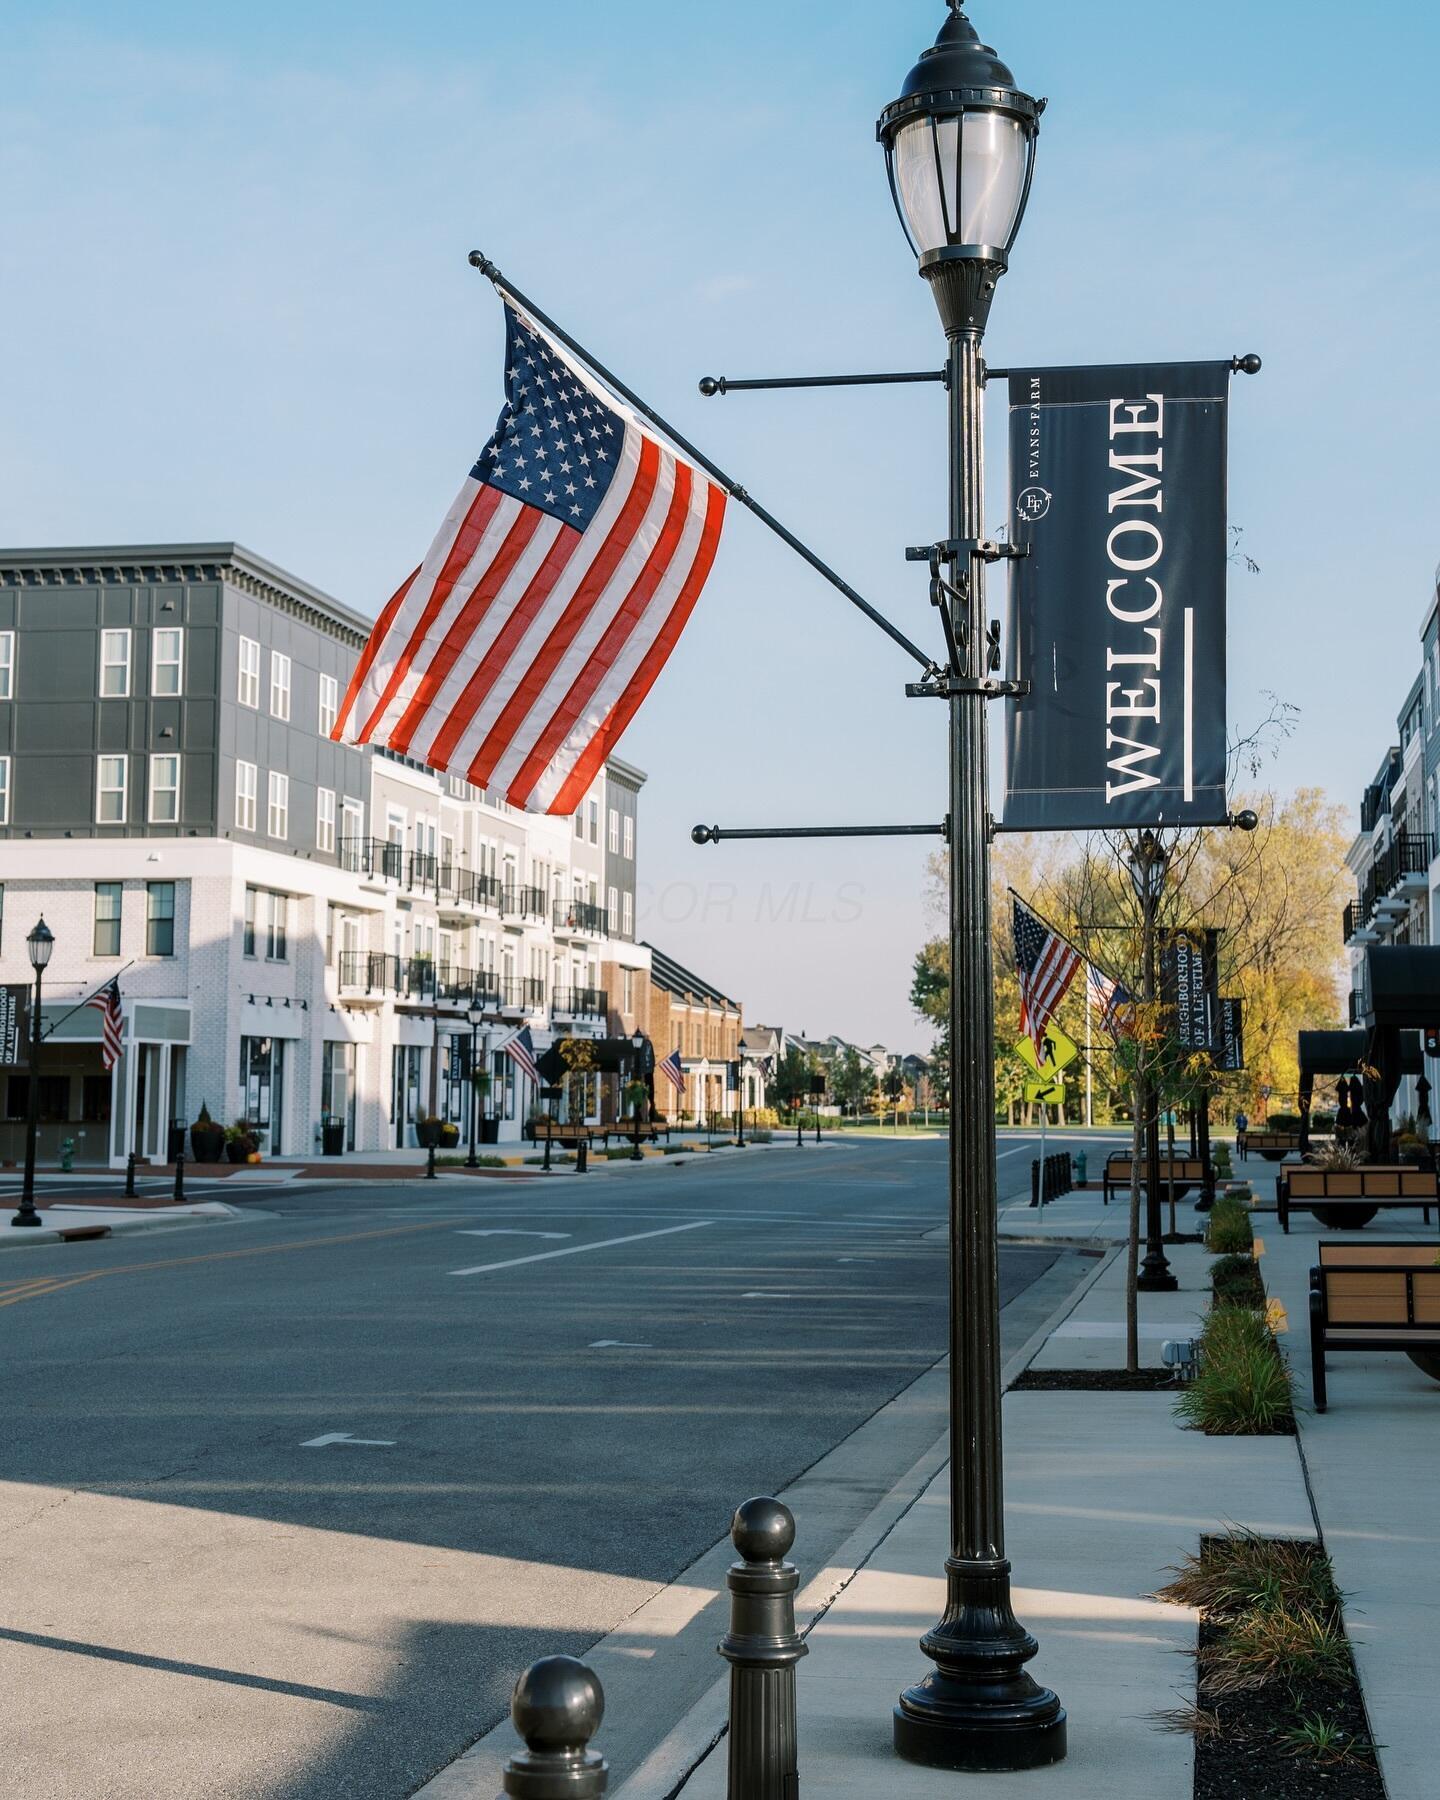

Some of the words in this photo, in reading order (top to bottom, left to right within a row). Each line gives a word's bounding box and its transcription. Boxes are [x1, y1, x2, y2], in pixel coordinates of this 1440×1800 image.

[1105, 393, 1164, 804] WELCOME
[1192, 949, 1204, 1012] LIFETIM
[7, 996, 16, 1040] LIFETIME
[1195, 1014, 1205, 1025] A
[1223, 1000, 1233, 1031] FARM
[1193, 1027, 1205, 1046] OF
[1224, 1033, 1235, 1068] EVANS
[5, 1050, 13, 1064] OF
